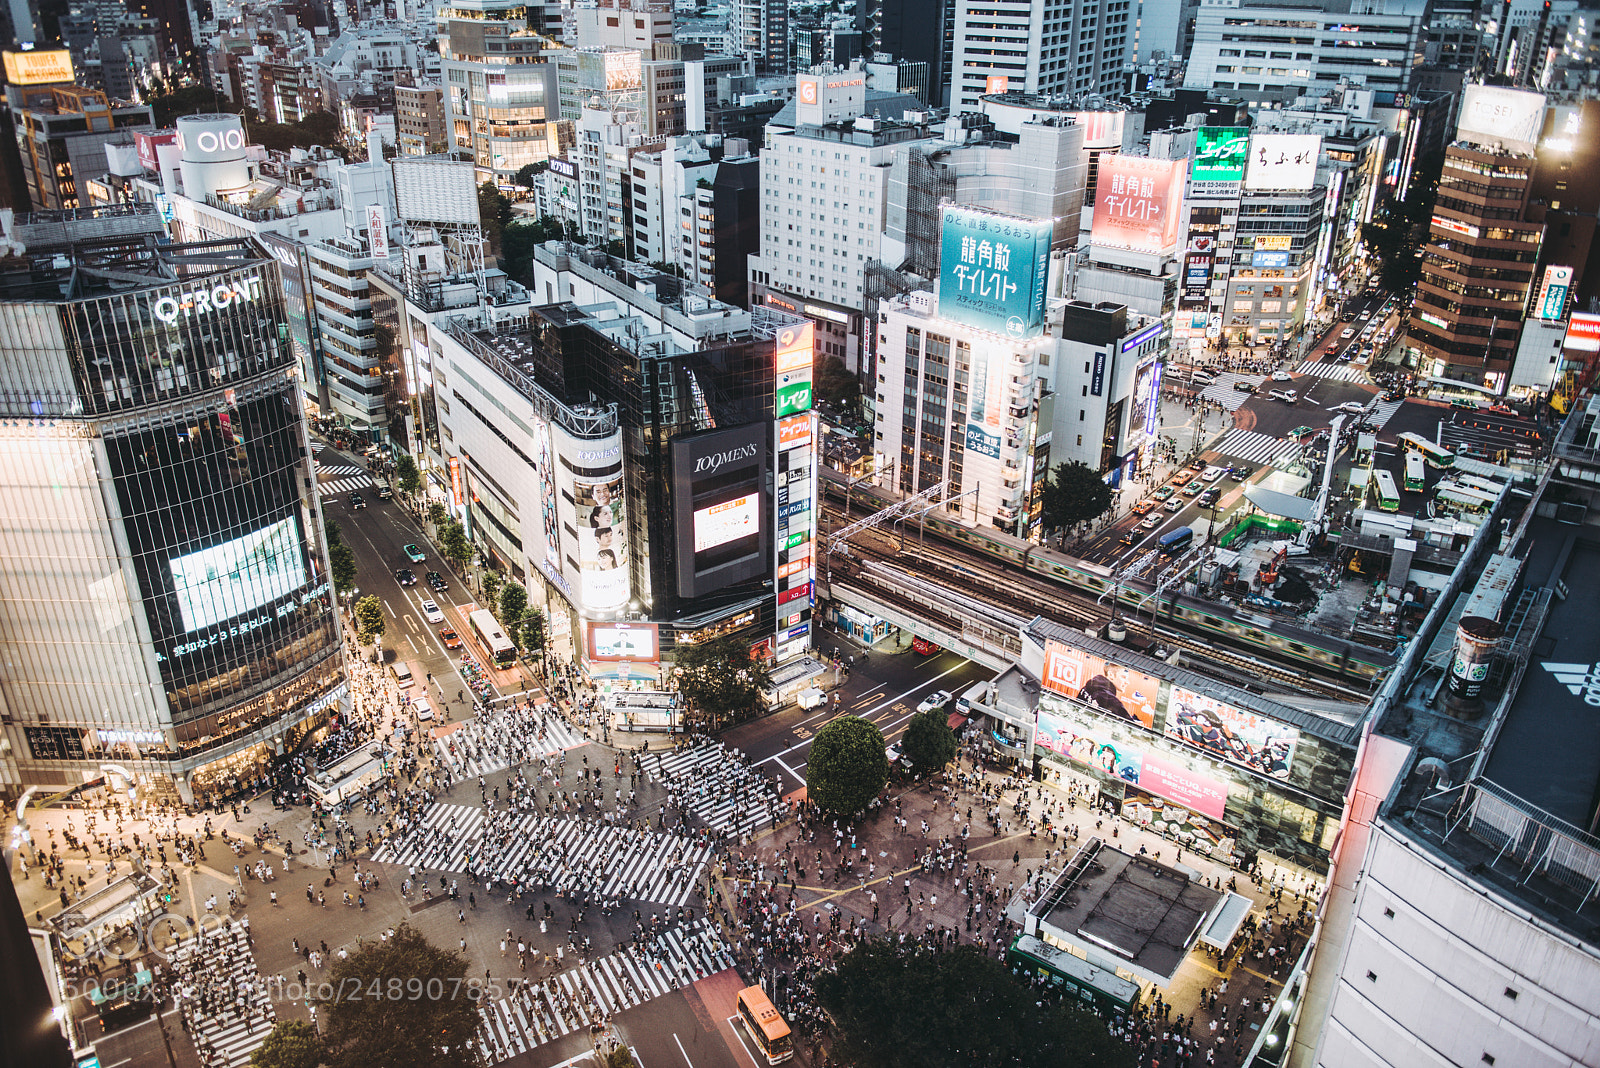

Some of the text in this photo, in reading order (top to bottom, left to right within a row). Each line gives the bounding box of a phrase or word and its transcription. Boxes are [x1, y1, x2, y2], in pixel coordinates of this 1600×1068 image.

[25, 54, 58, 68] TOWER
[24, 67, 68, 81] RECORDS
[827, 81, 842, 89] TOKYU
[1196, 137, 1249, 159] エイブル
[1111, 173, 1155, 199] 龍角散
[370, 210, 384, 248] 大和証券
[961, 235, 1011, 272] 龍角散
[953, 264, 1018, 301] ダイレクト
[956, 294, 984, 307] スティック
[780, 389, 809, 408] レイク
[780, 421, 810, 438] アイフル
[970, 441, 996, 456] うるおう
[217, 676, 310, 724] STARBUCKS COFFEE
[306, 684, 348, 716] TSUTAYA
[97, 730, 165, 743] TSUTAYA
